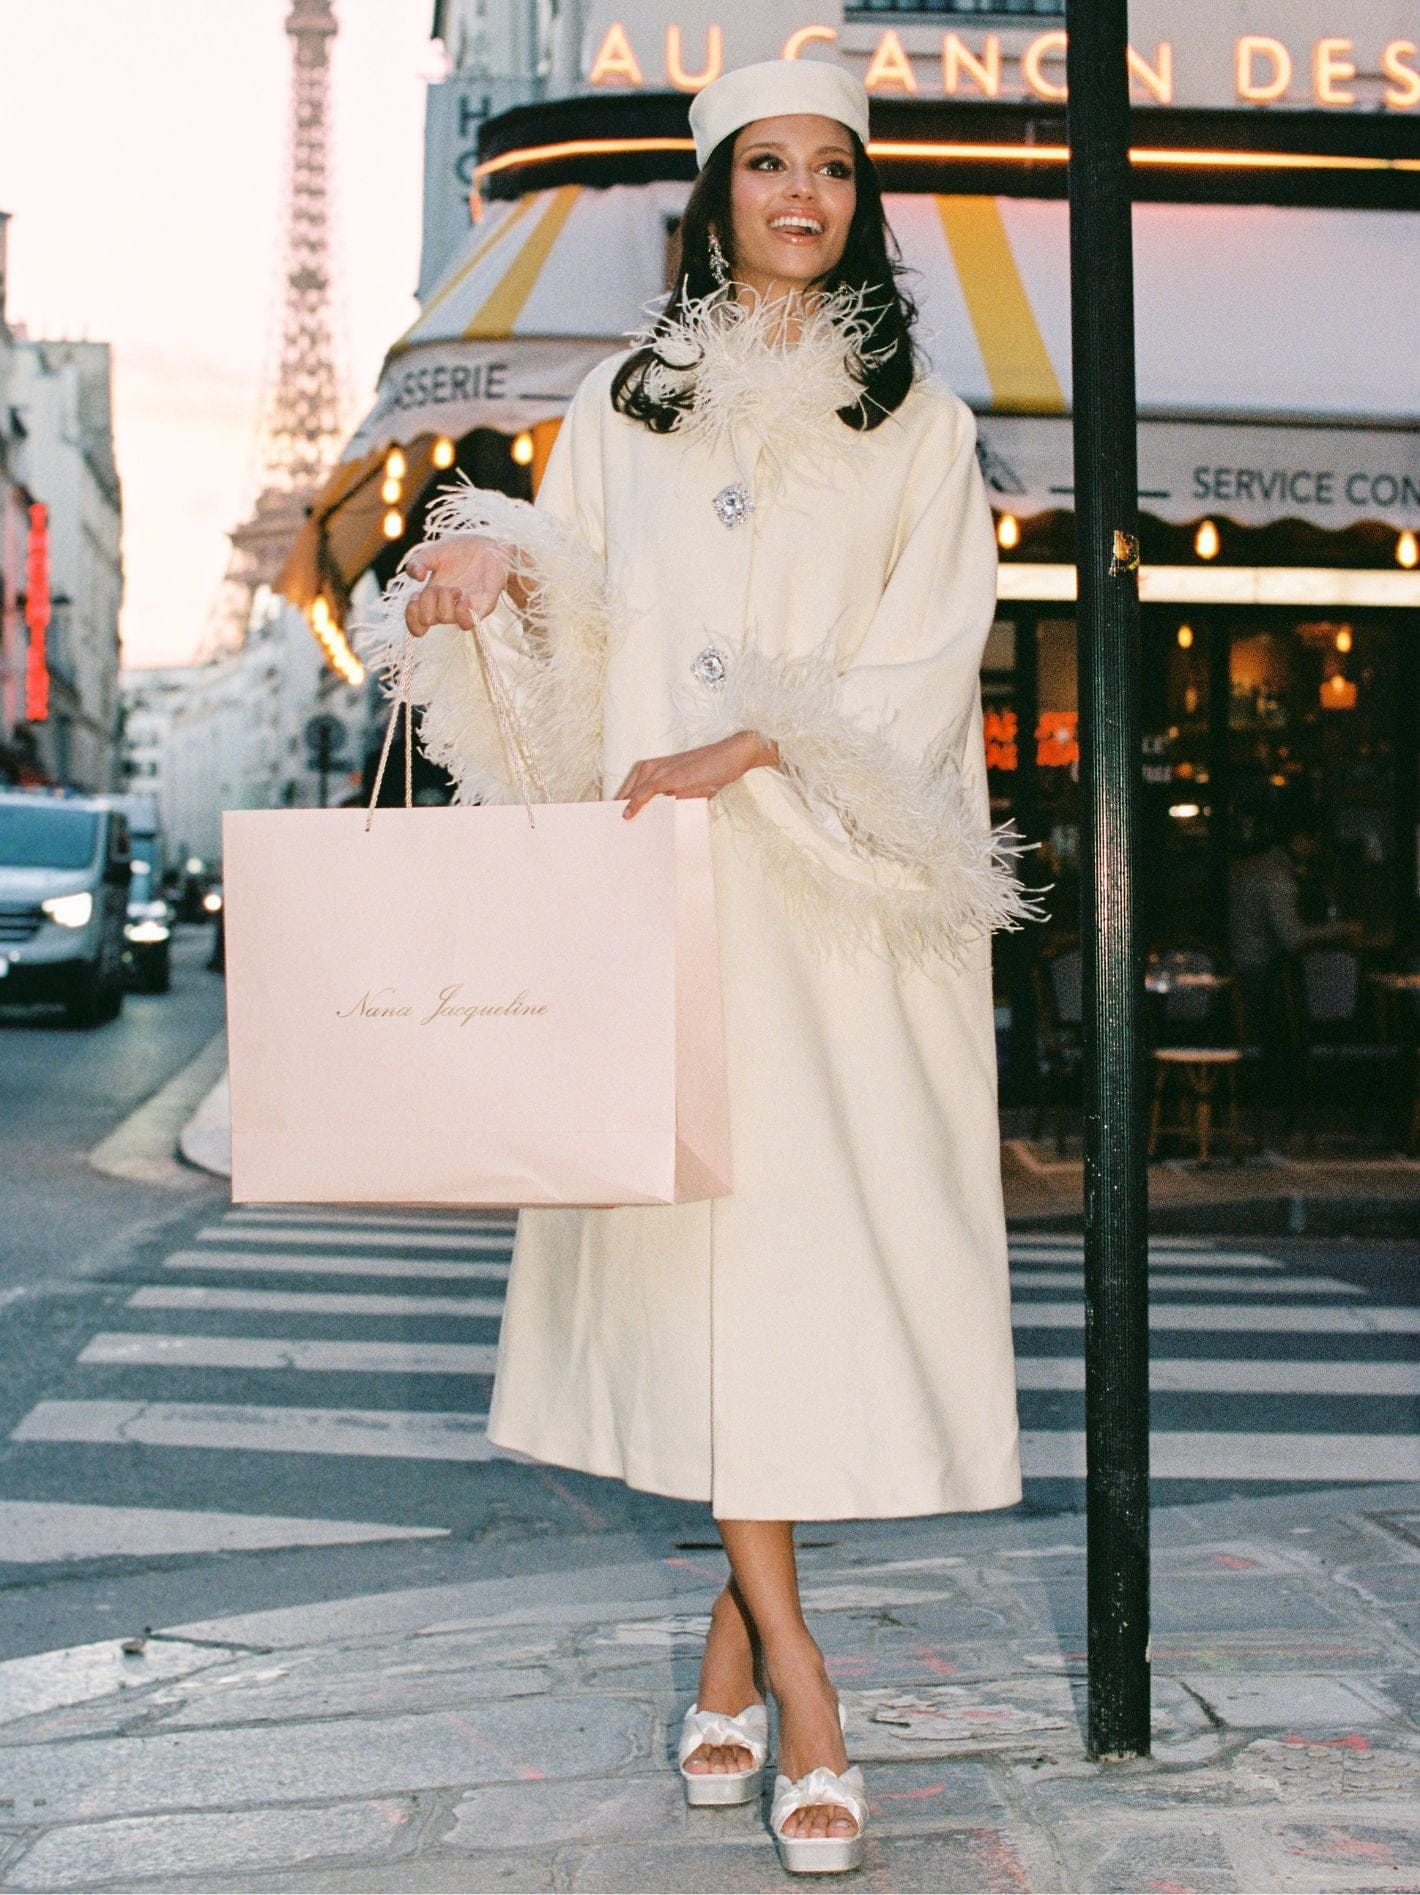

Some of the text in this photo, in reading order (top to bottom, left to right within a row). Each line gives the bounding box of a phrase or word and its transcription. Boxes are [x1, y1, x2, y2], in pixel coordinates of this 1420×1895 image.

[588, 20, 724, 94] AU
[1235, 34, 1420, 109] DES
[1193, 465, 1334, 504] SERVICE
[336, 982, 549, 1028] Nana Jacqueline
